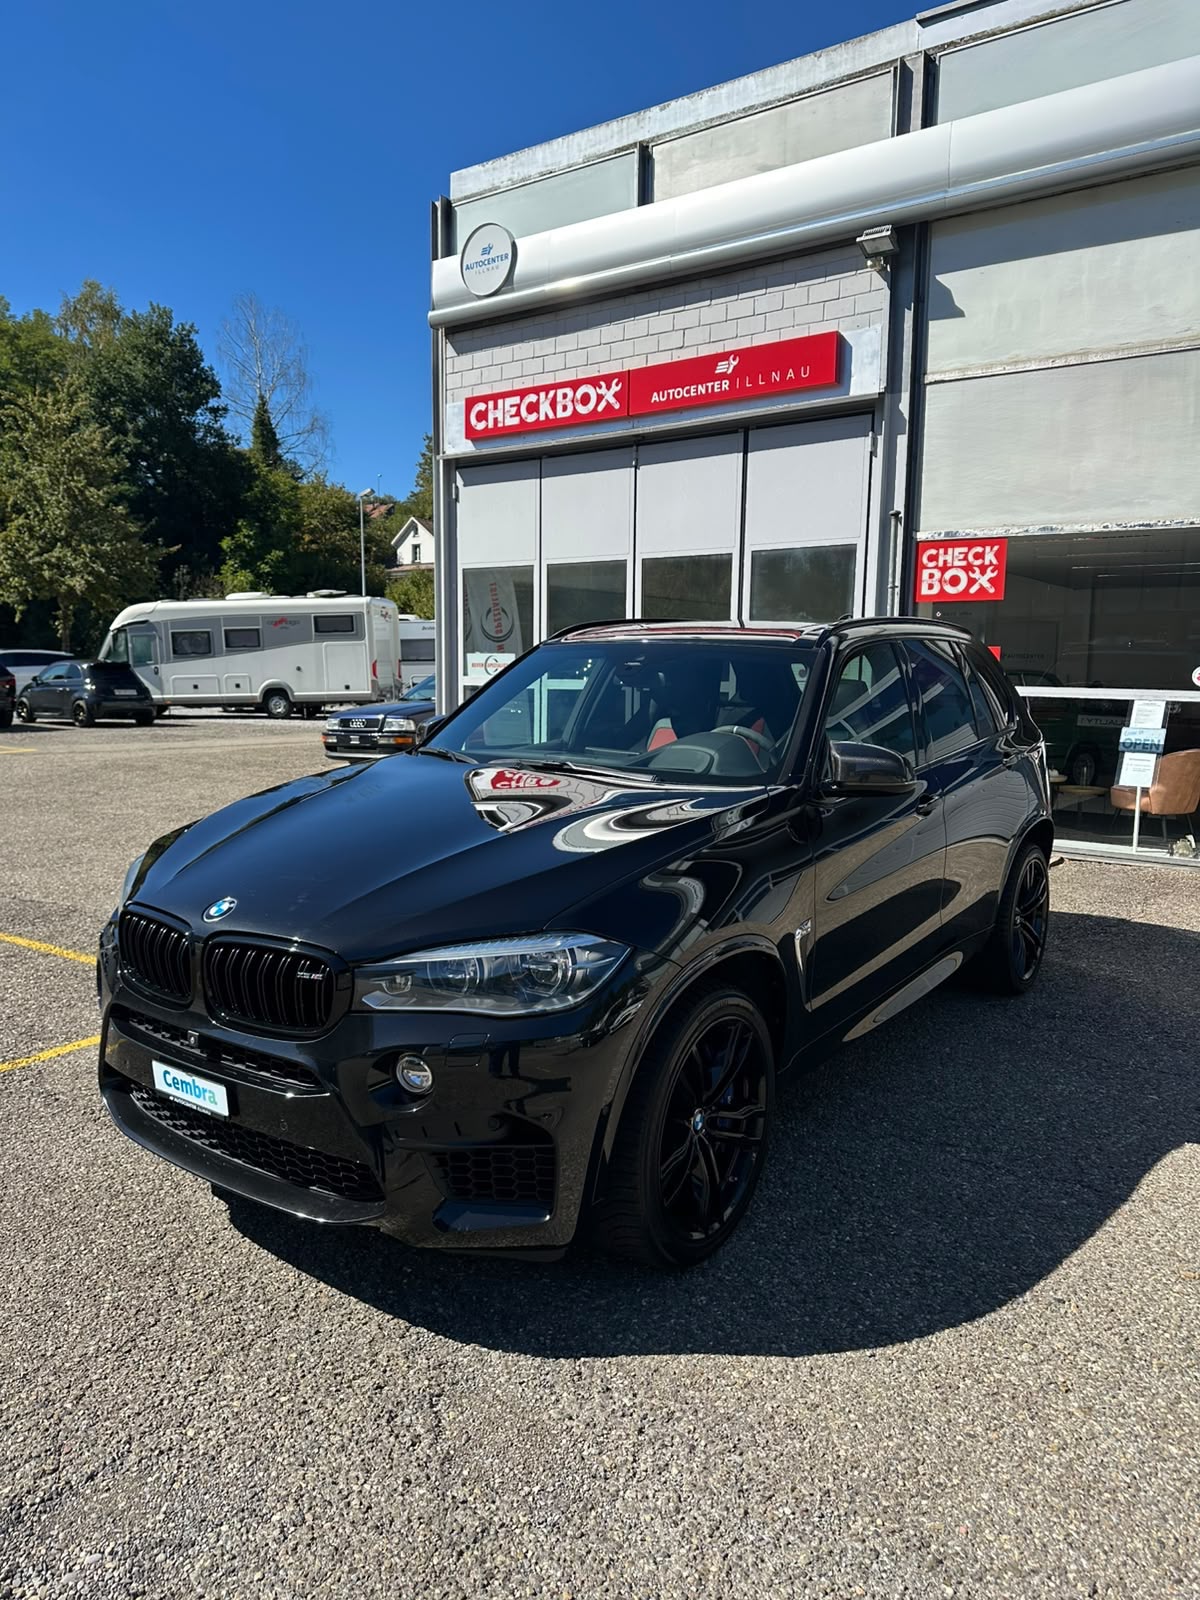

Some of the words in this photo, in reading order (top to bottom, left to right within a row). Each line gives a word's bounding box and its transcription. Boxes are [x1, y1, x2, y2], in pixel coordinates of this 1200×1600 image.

[465, 252, 509, 271] AUTOCENTER
[475, 265, 499, 275] ILLNAU
[651, 379, 730, 403] AUTOCENTER
[736, 365, 810, 389] ILLNAU
[469, 378, 622, 431] CHECKBOX
[922, 545, 1000, 568] CHECK
[920, 565, 999, 596] BOX
[1122, 738, 1161, 751] OPEN
[162, 1069, 218, 1105] Cembra
